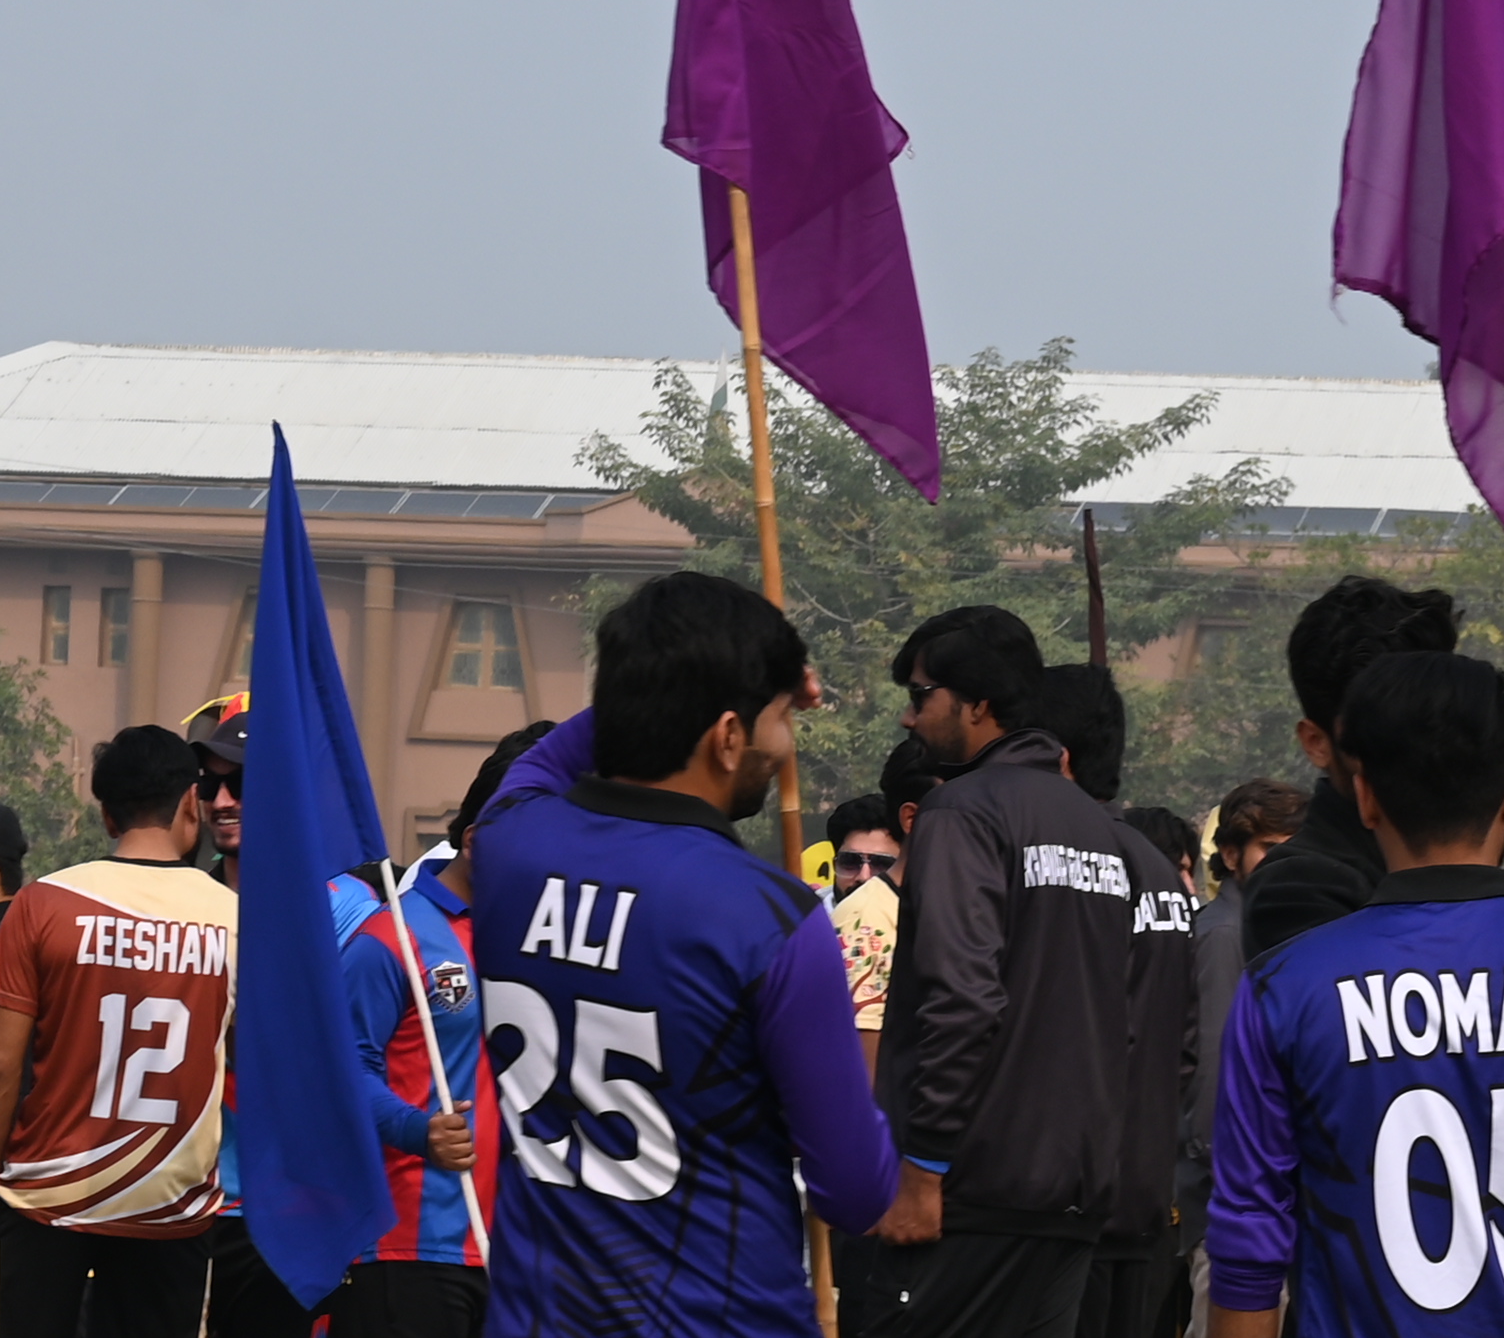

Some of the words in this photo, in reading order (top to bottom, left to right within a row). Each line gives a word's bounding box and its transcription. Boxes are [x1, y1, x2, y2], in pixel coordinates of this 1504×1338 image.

[76, 915, 227, 977] ZEESHAN
[520, 877, 637, 970] ALI
[90, 993, 191, 1125] 12
[481, 976, 682, 1202] 25
